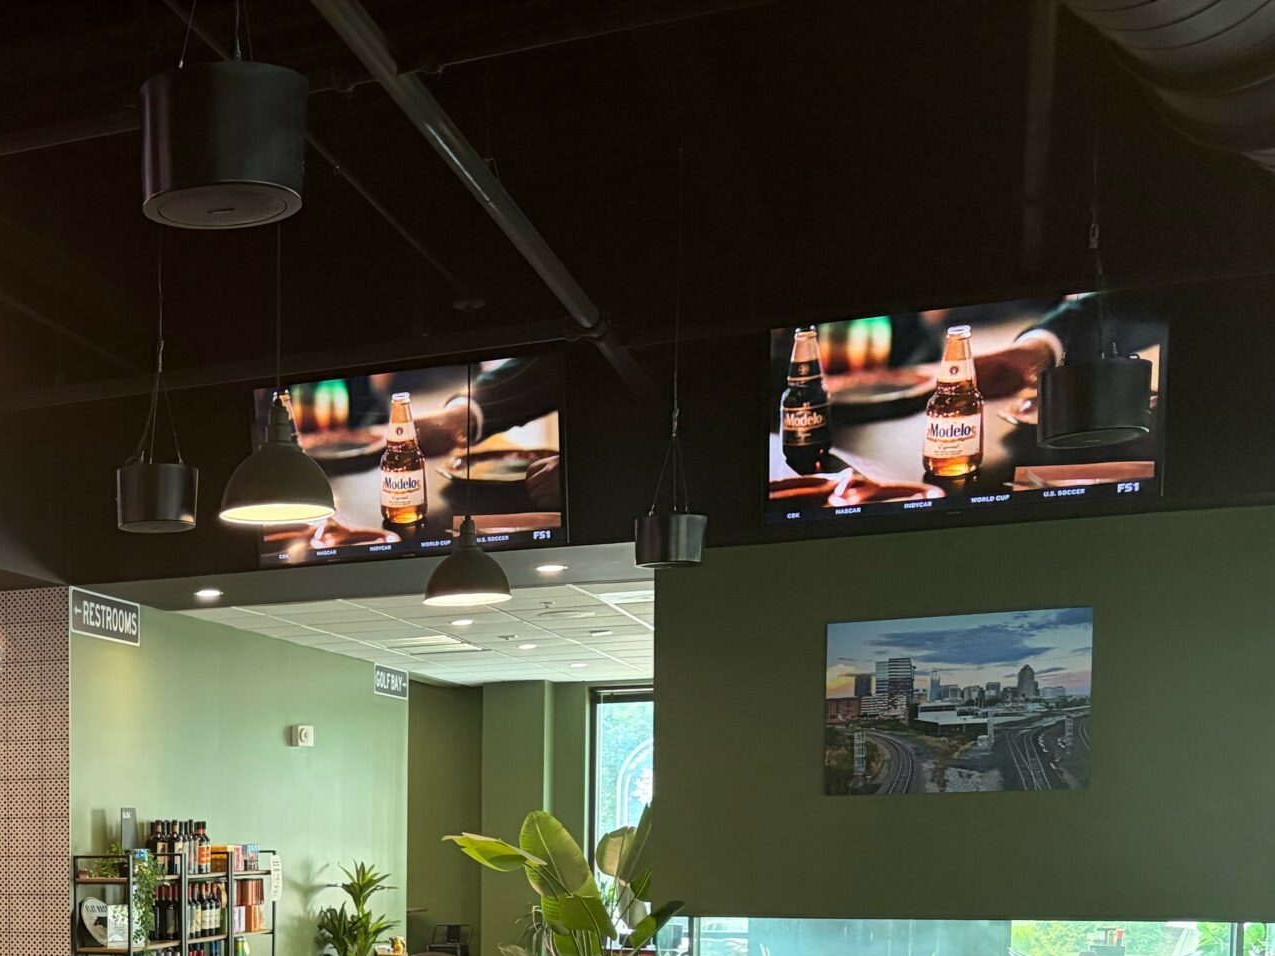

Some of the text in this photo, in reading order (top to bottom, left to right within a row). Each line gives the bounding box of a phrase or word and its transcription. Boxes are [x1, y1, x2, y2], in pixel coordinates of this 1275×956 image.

[785, 412, 823, 427] Modelo
[930, 423, 971, 438] Modelo
[385, 477, 417, 490] Modelo
[1116, 482, 1140, 493] FS1
[1043, 488, 1086, 498] U.S. SOCCER
[835, 507, 862, 515] NASCAR
[904, 501, 933, 509] INDYCAR
[533, 530, 551, 540] FS1
[82, 600, 137, 636] RESTROOMS
[376, 670, 403, 692] GOLF BAY
